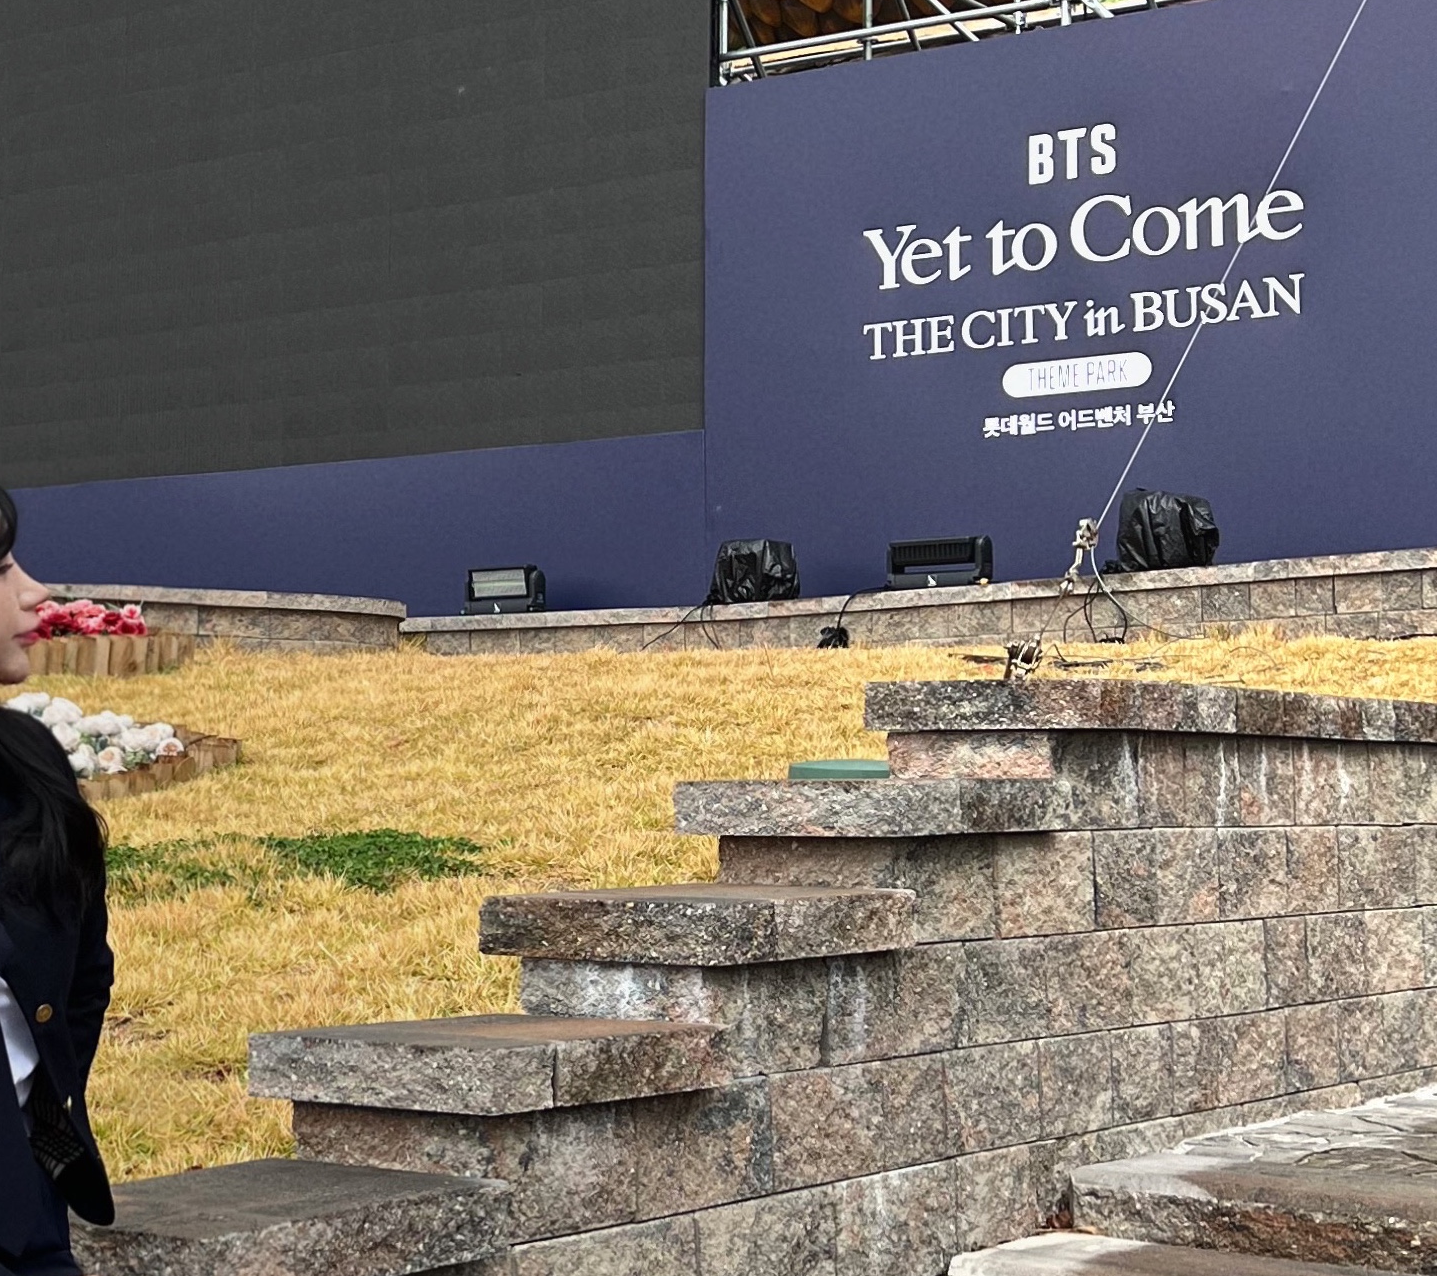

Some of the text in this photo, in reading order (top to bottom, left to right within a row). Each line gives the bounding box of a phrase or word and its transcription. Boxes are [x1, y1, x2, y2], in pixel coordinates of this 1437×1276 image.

[1027, 123, 1117, 185] BTS
[863, 188, 1305, 291] Yet to Come
[863, 273, 1306, 361] THE CITY in BUSAN
[1027, 359, 1129, 391] THEME PARK
[982, 400, 1176, 439] 롯데월드 어드벤처 부산
